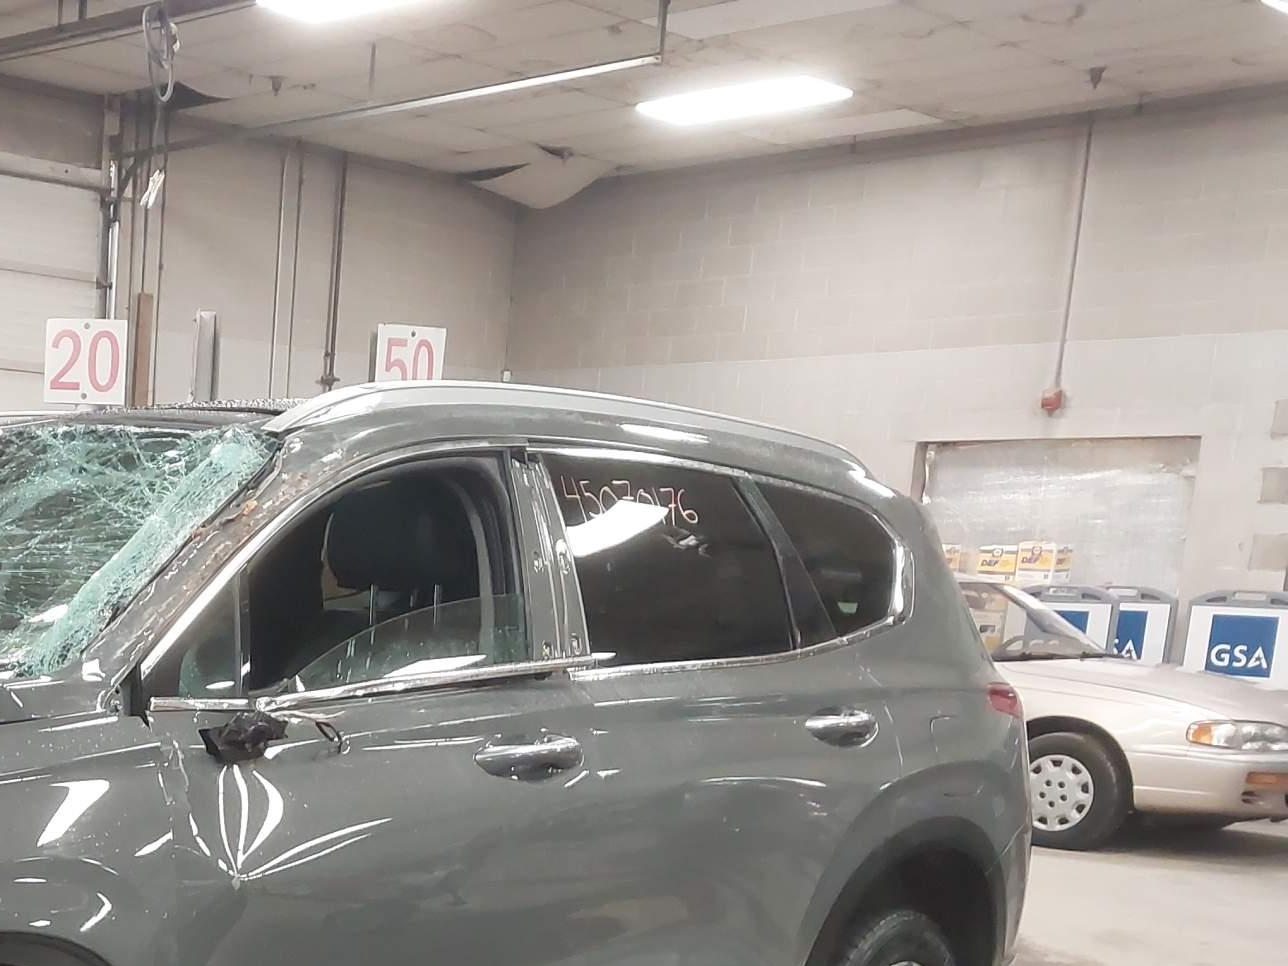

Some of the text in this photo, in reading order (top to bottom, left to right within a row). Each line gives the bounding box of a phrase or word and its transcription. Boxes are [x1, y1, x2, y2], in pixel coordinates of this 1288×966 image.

[49, 329, 121, 392] 20
[384, 338, 435, 380] 50
[1210, 643, 1268, 669] GSA
